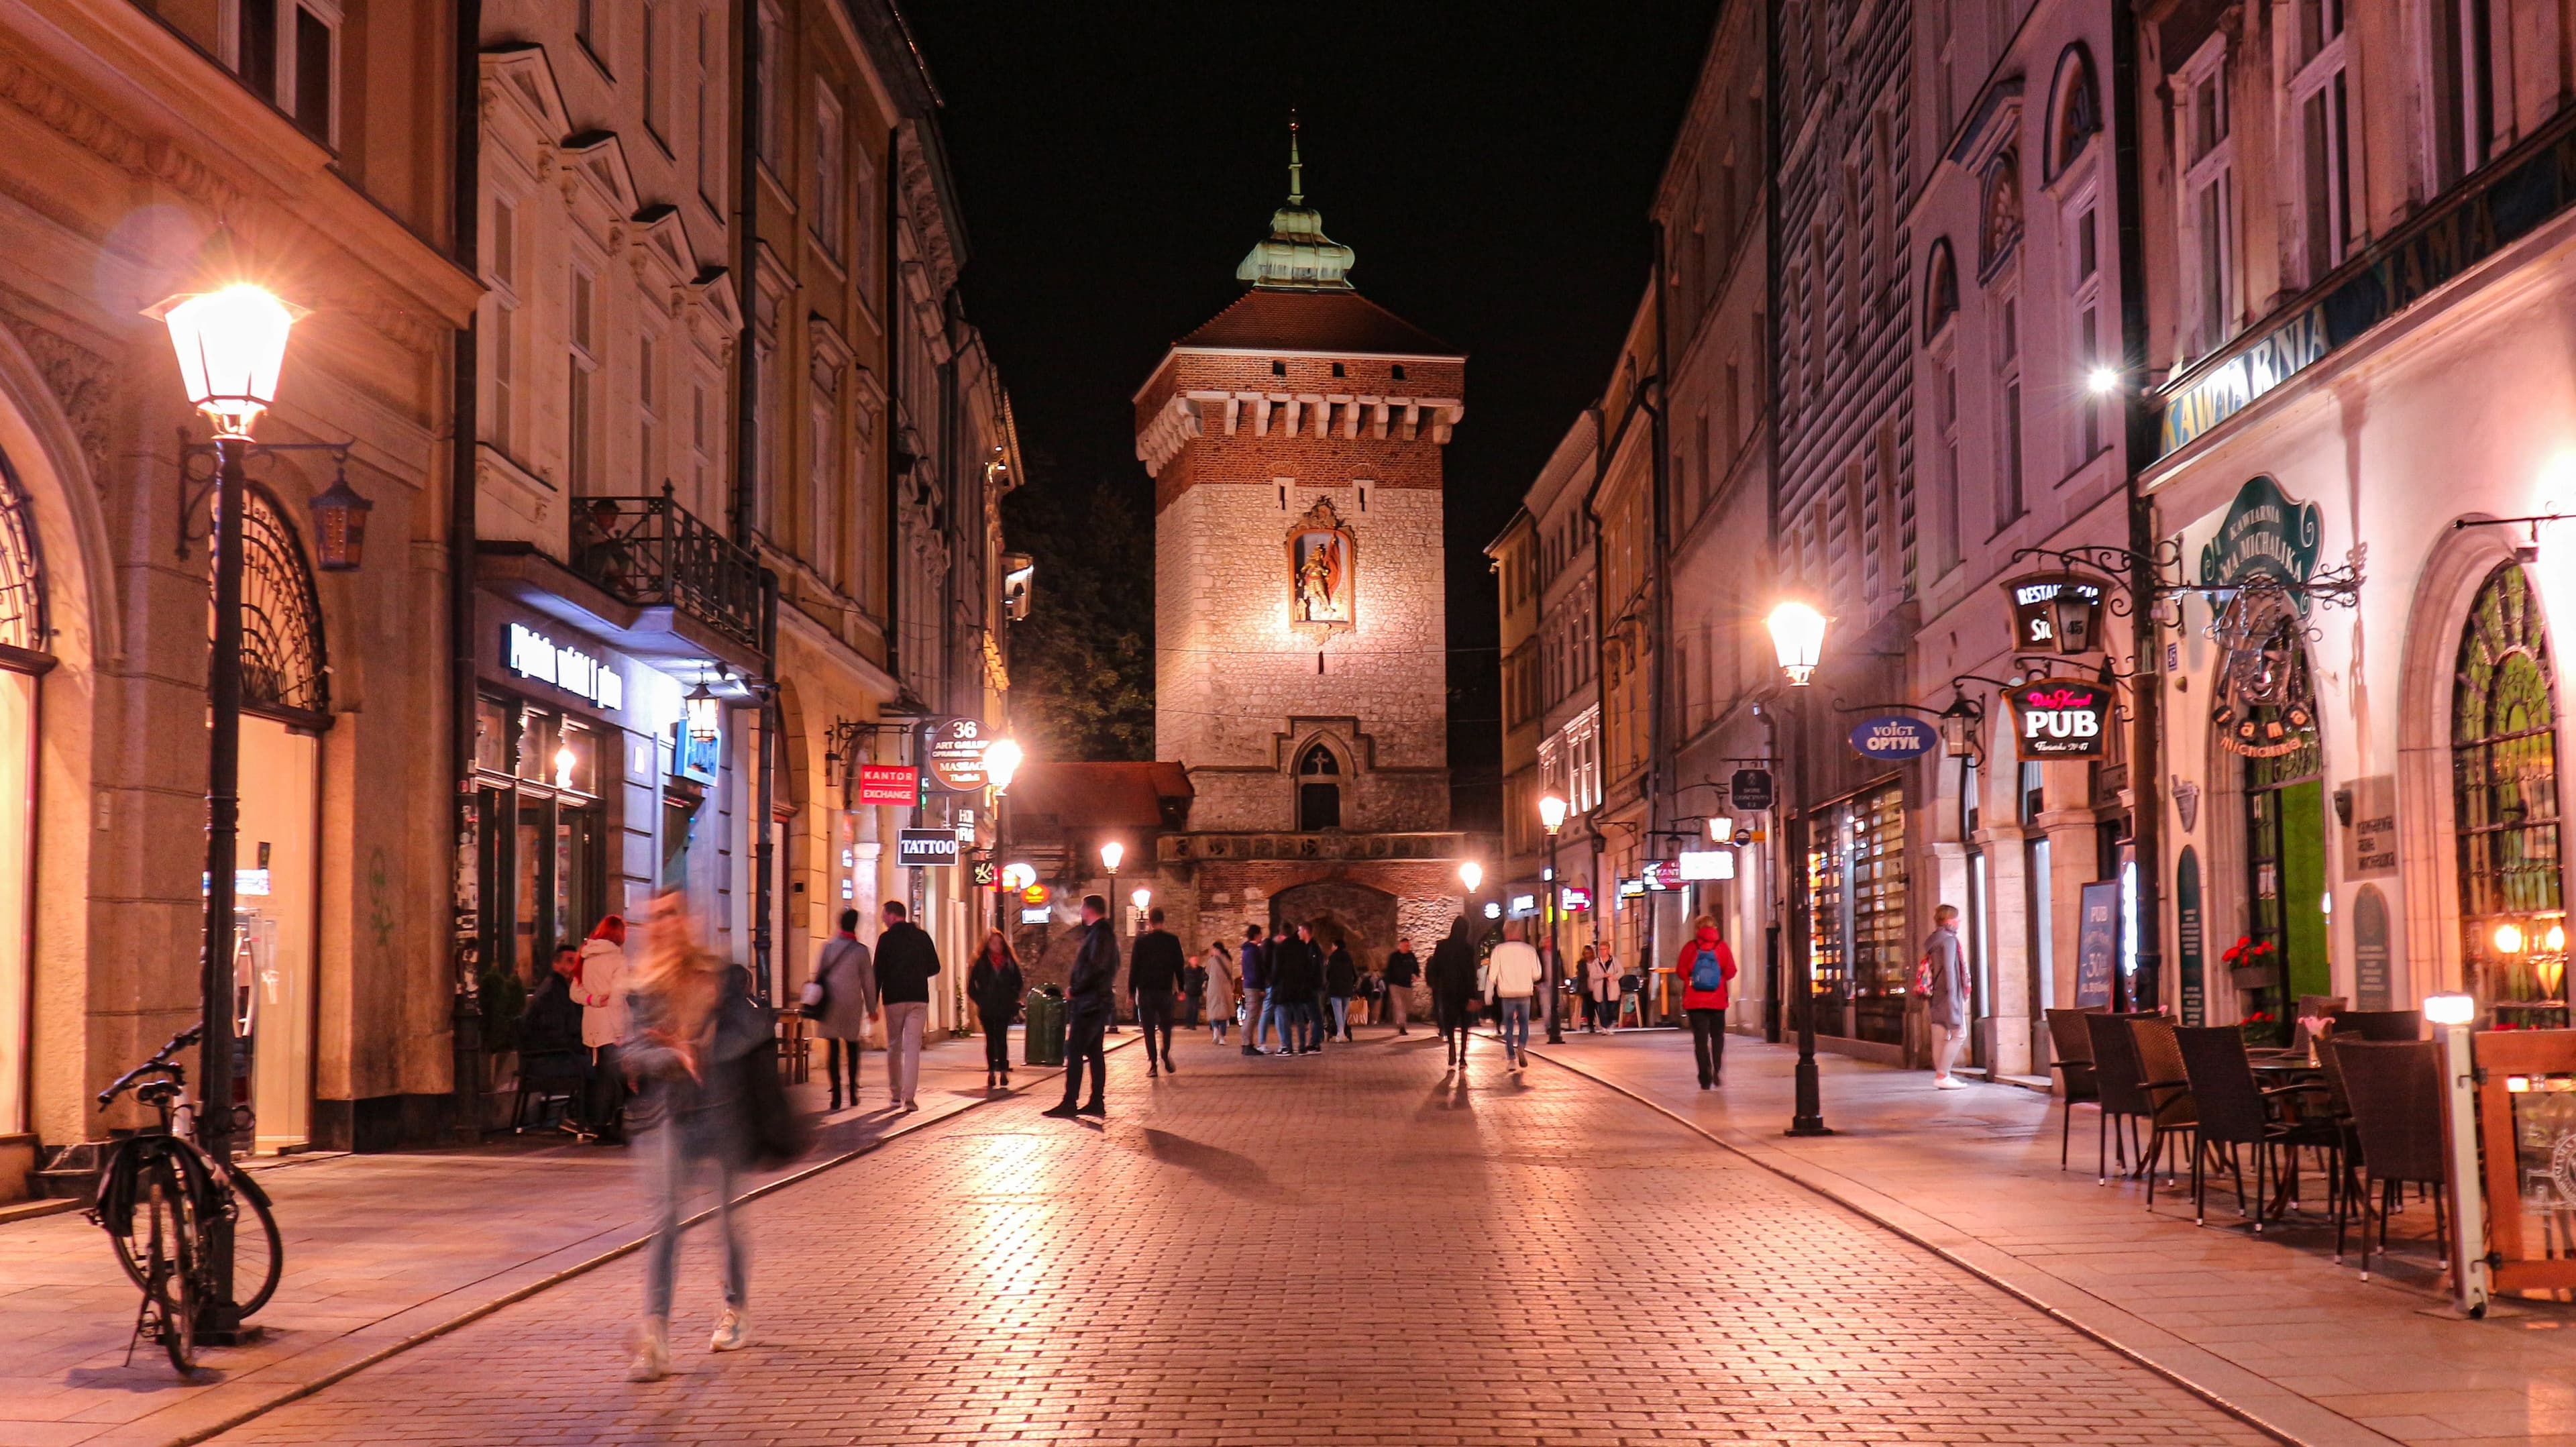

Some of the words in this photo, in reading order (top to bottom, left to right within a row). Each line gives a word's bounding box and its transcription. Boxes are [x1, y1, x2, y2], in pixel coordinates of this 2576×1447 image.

[2230, 504, 2281, 541] KAWIARNIA
[2239, 531, 2302, 583] MICHALIKA
[953, 720, 977, 739] 36
[2025, 710, 2099, 738] PUB
[934, 741, 953, 750] ART
[1866, 736, 1921, 751] OPTYK
[939, 761, 987, 771] MASSAG
[863, 771, 914, 782] KANTOR
[863, 789, 913, 800] EXCHANGE
[901, 839, 956, 855] TATTOO
